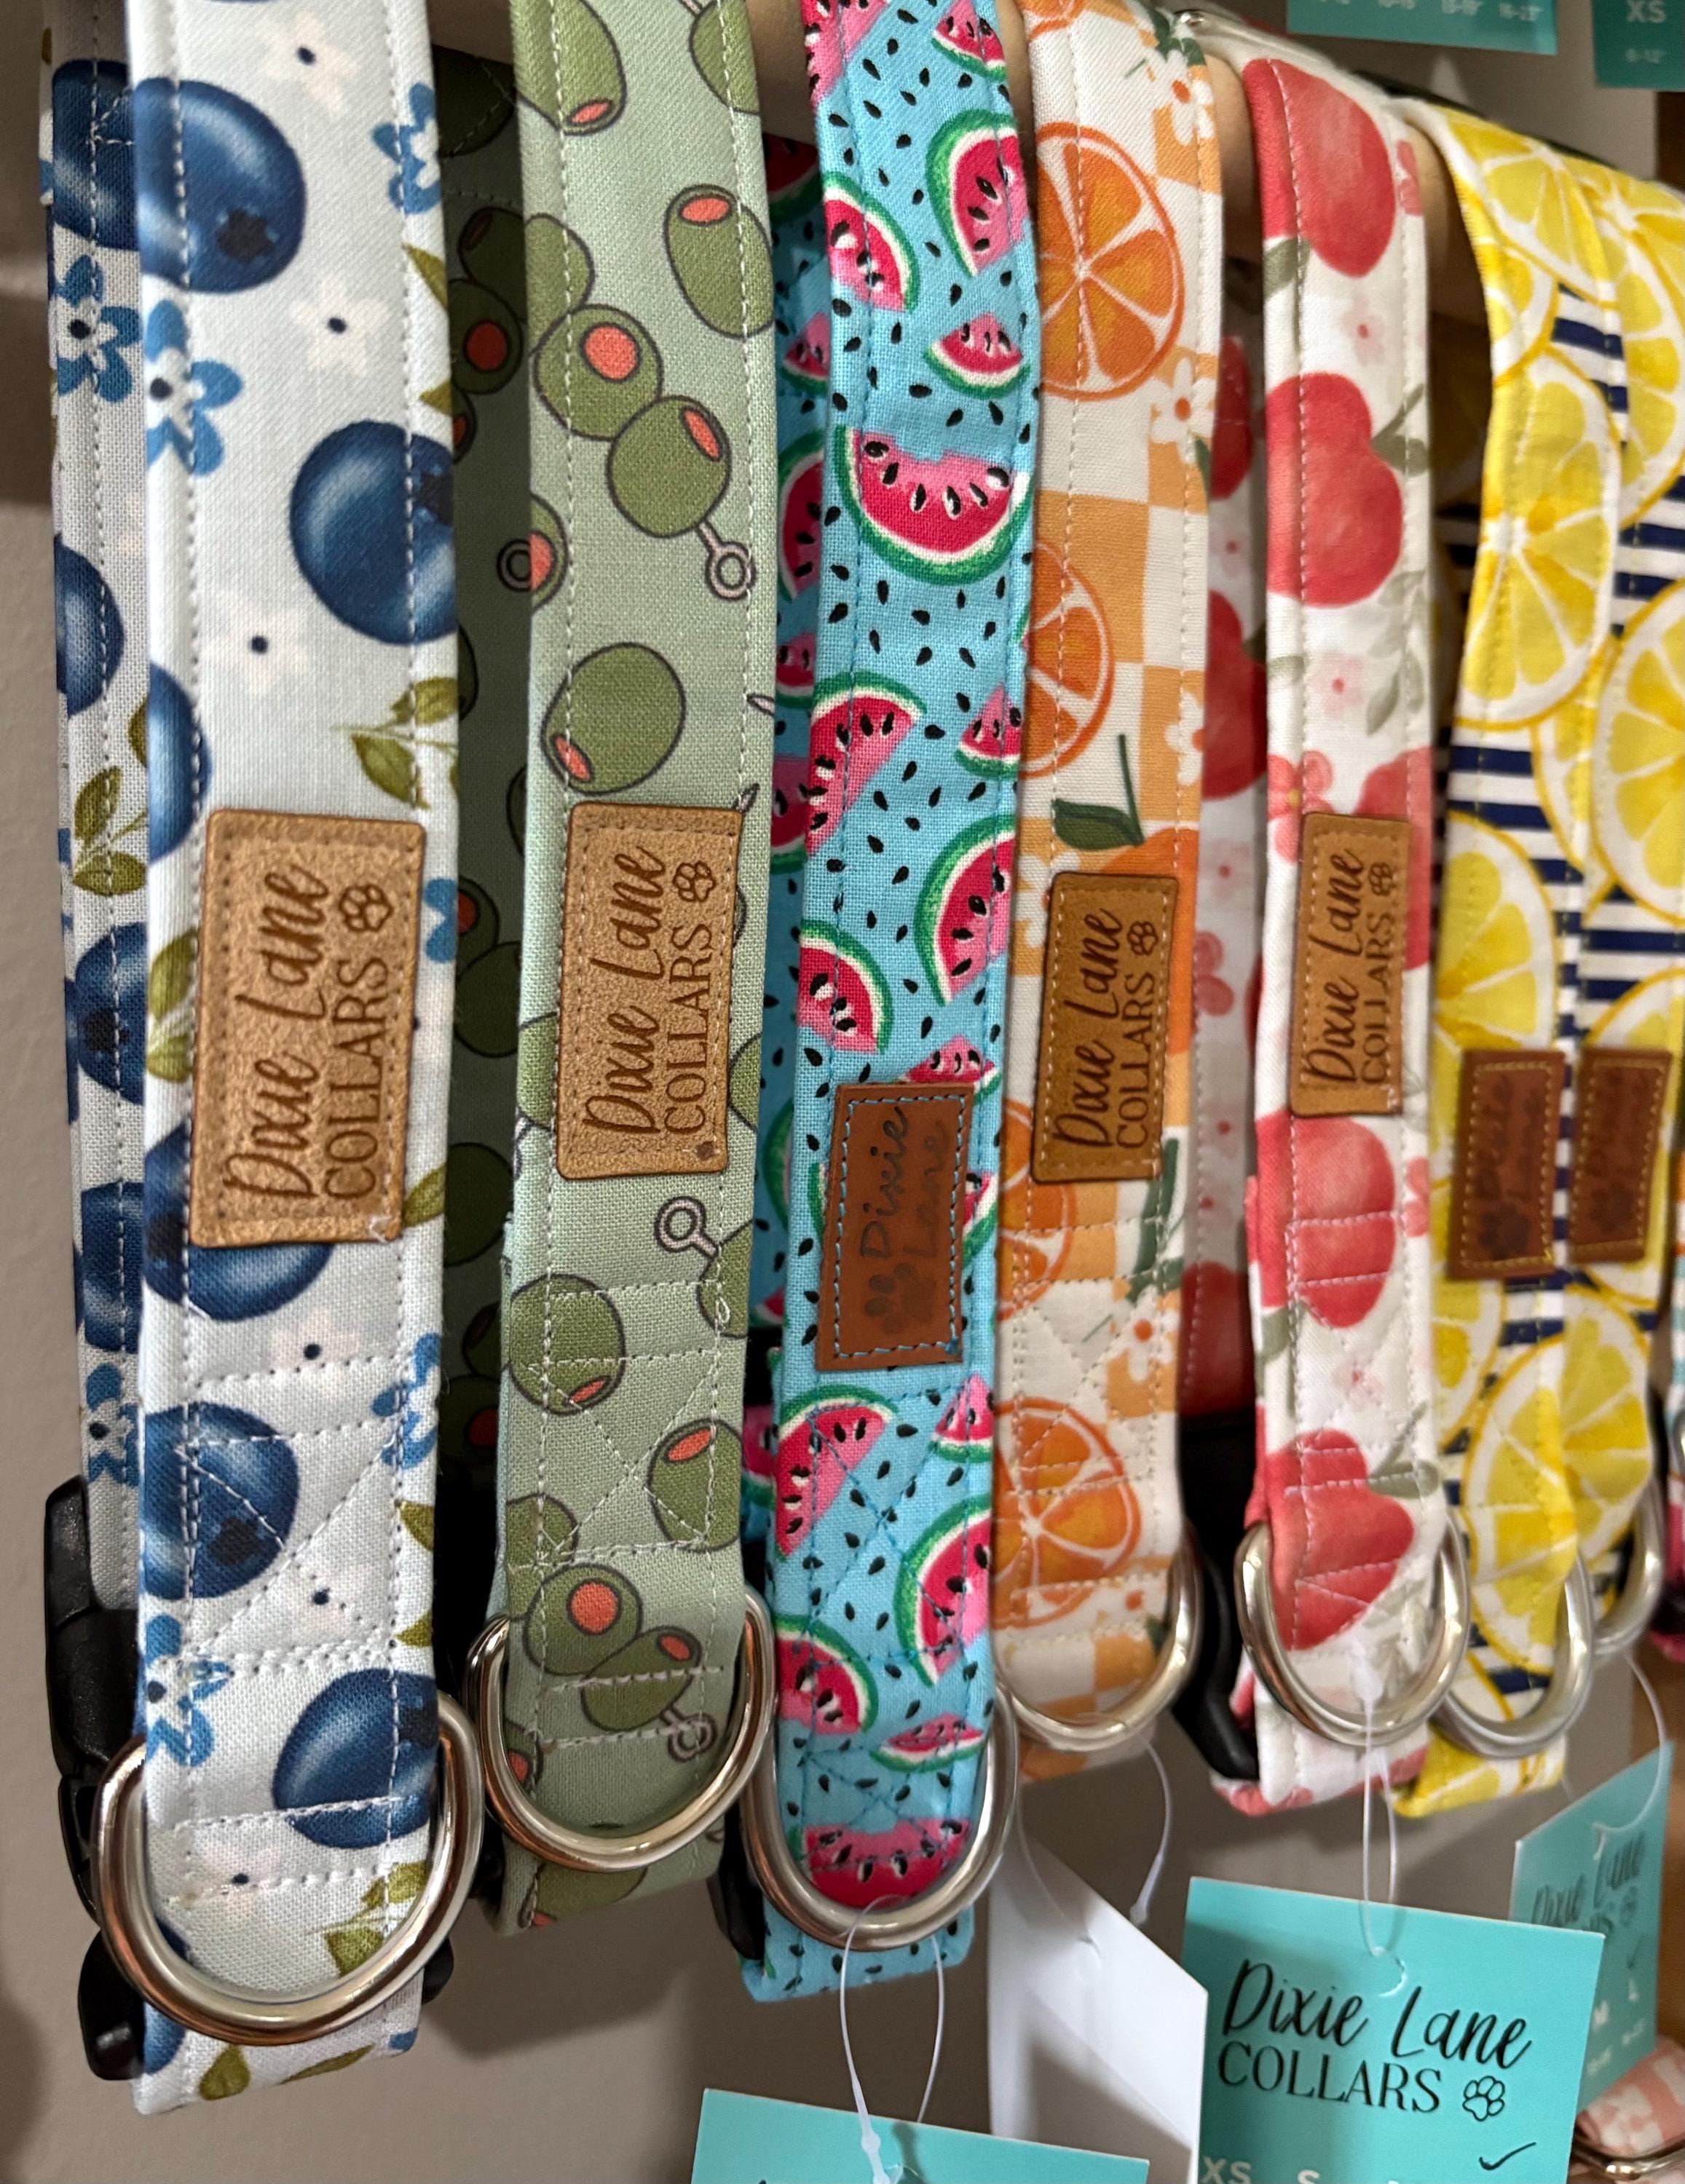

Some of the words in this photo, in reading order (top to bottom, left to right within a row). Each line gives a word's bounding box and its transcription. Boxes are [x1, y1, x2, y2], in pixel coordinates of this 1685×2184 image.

[1627, 0, 1667, 23] XS
[236, 865, 328, 1019] Lane
[590, 847, 666, 981] Lane
[1063, 908, 1122, 1018] Lane
[1309, 848, 1364, 956] Lane
[664, 925, 711, 1134] COLLARS
[1116, 972, 1155, 1148] COLLARS
[1304, 976, 1359, 1083] Dixie
[1360, 912, 1392, 1083] COLLARS
[223, 1055, 320, 1198] Dixie
[325, 958, 388, 1199] COLLARS
[583, 1005, 660, 1133] Dixie
[1053, 1040, 1116, 1147] Dixie
[860, 1107, 909, 1258] Dixie
[1218, 2041, 1441, 2113] COLLARS
[1223, 1959, 1368, 2046] Dixie
[1391, 1986, 1532, 2069] Lane
[1201, 2156, 1252, 2184] XS
